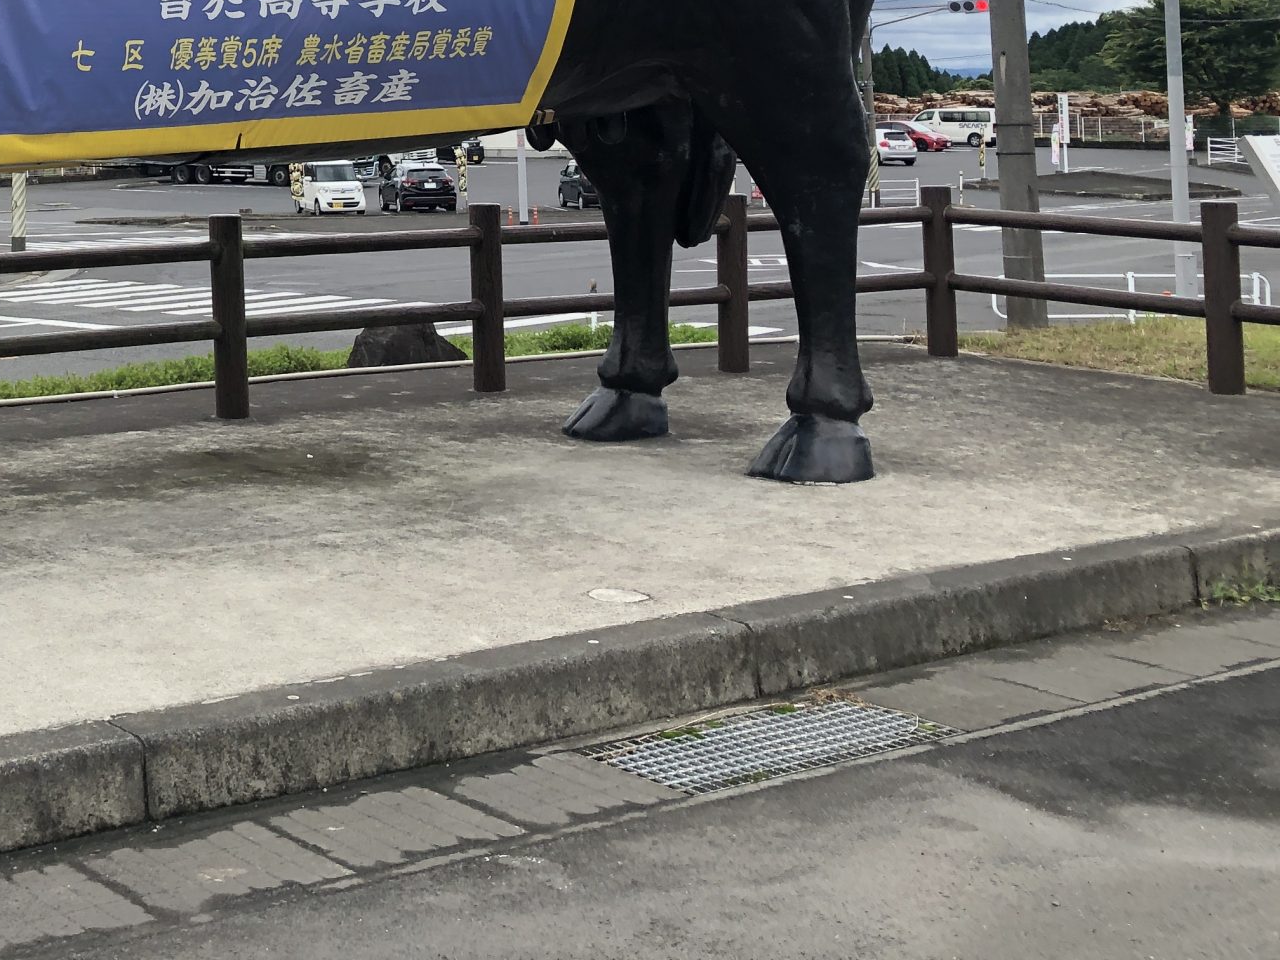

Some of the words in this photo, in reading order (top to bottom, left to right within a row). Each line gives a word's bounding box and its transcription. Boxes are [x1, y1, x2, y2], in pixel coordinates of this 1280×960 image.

[170, 35, 283, 72] 優等賞5席
[296, 26, 494, 66] 農水省畜産局賞受賞
